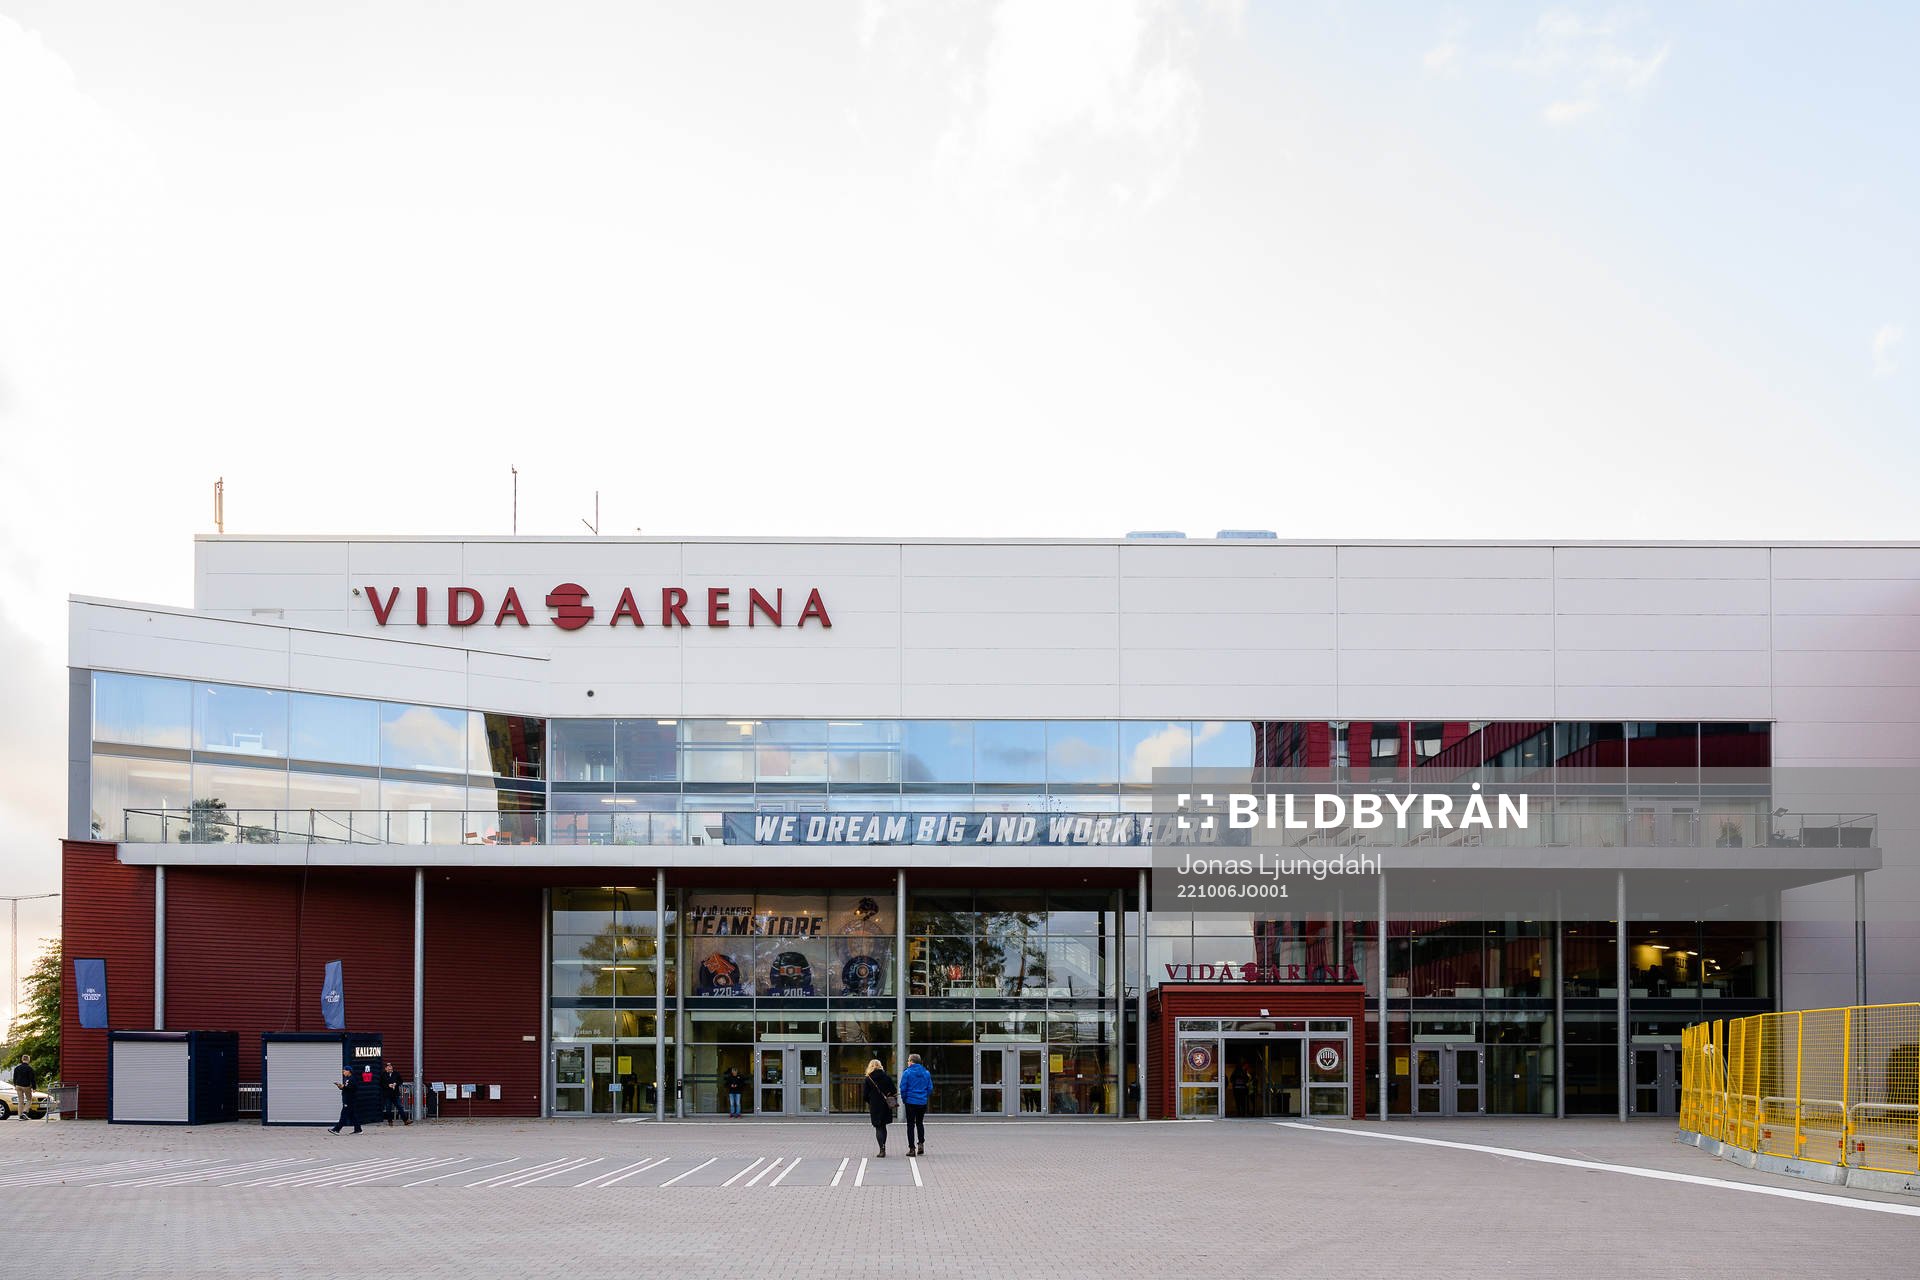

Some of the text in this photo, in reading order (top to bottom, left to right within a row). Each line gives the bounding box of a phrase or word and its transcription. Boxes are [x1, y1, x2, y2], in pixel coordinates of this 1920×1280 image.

[364, 586, 833, 628] VIDA ARENA
[754, 815, 1221, 844] WE DREAM BIG AND WORK HARD
[720, 906, 753, 916] LAKERS
[1164, 963, 1360, 981] VIDA ARENA
[355, 1046, 382, 1057] KALLZON
